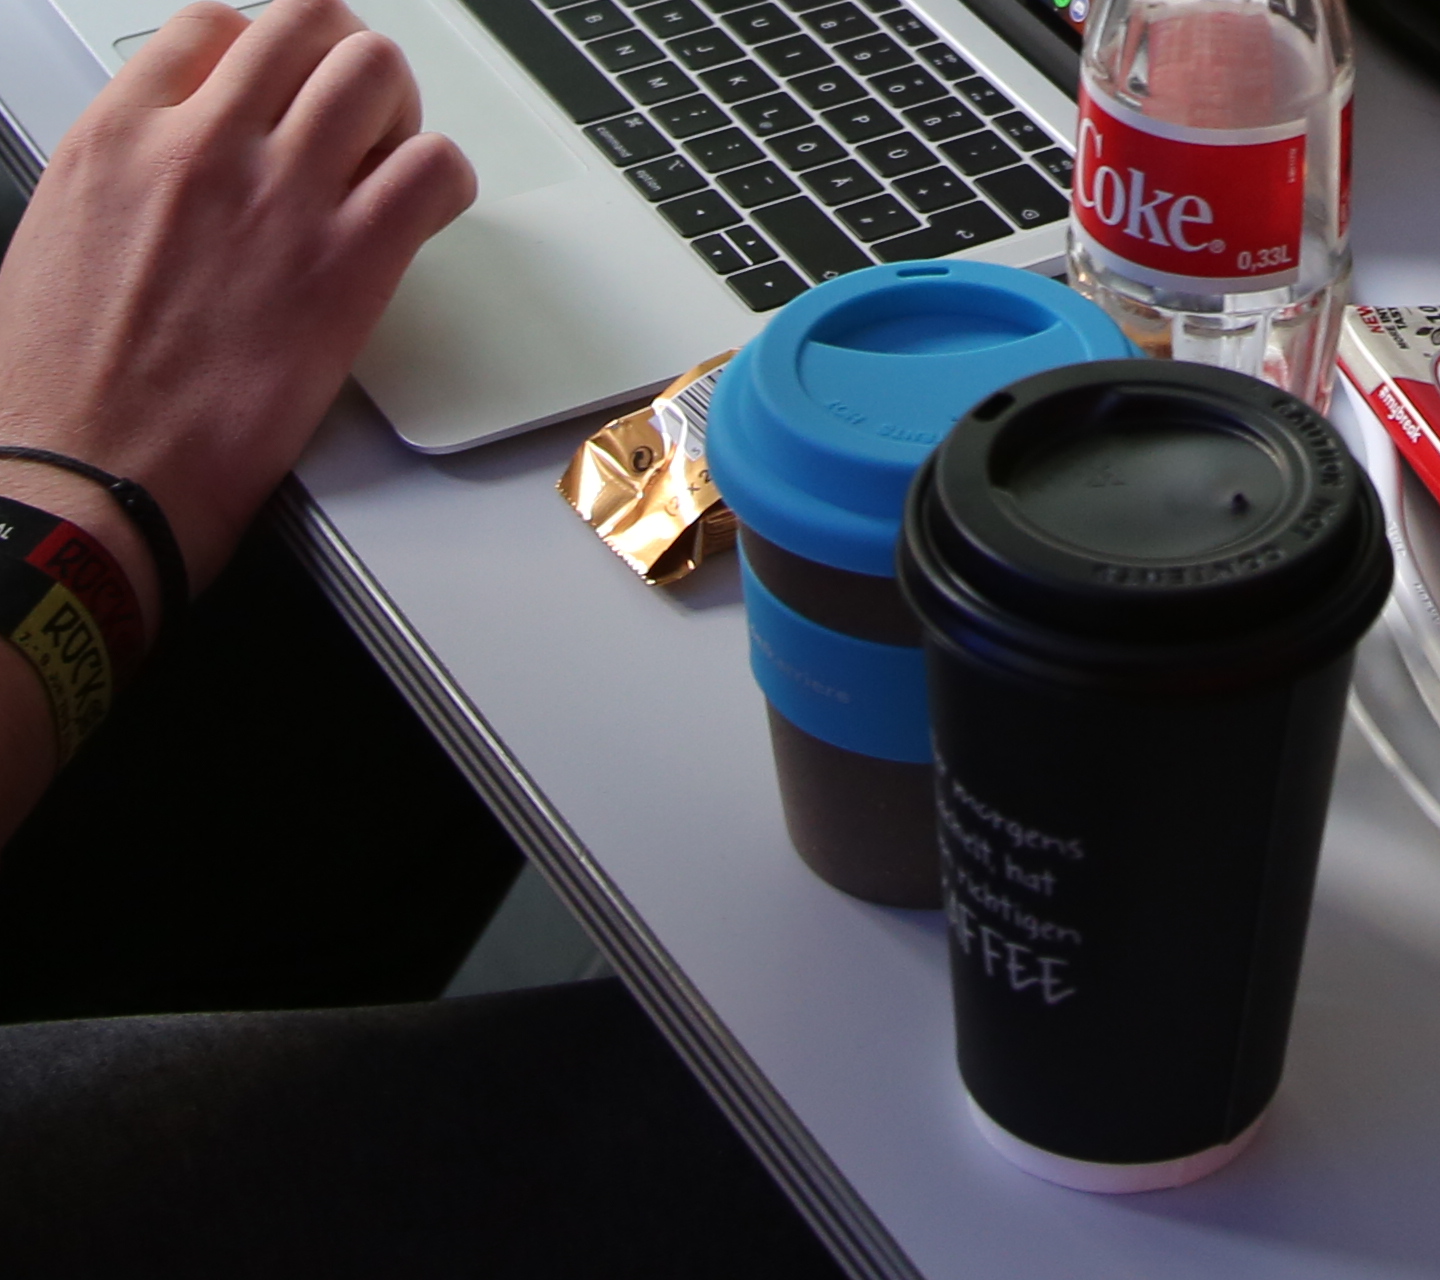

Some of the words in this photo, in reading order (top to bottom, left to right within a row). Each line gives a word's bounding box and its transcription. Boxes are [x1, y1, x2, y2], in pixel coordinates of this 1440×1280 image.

[1075, 117, 1214, 253] Coke
[1236, 244, 1293, 271] 0,33L
[1356, 306, 1386, 334] NEW
[42, 601, 107, 711] ROCK
[1004, 853, 1058, 897] hat
[956, 870, 1083, 945] richtigen
